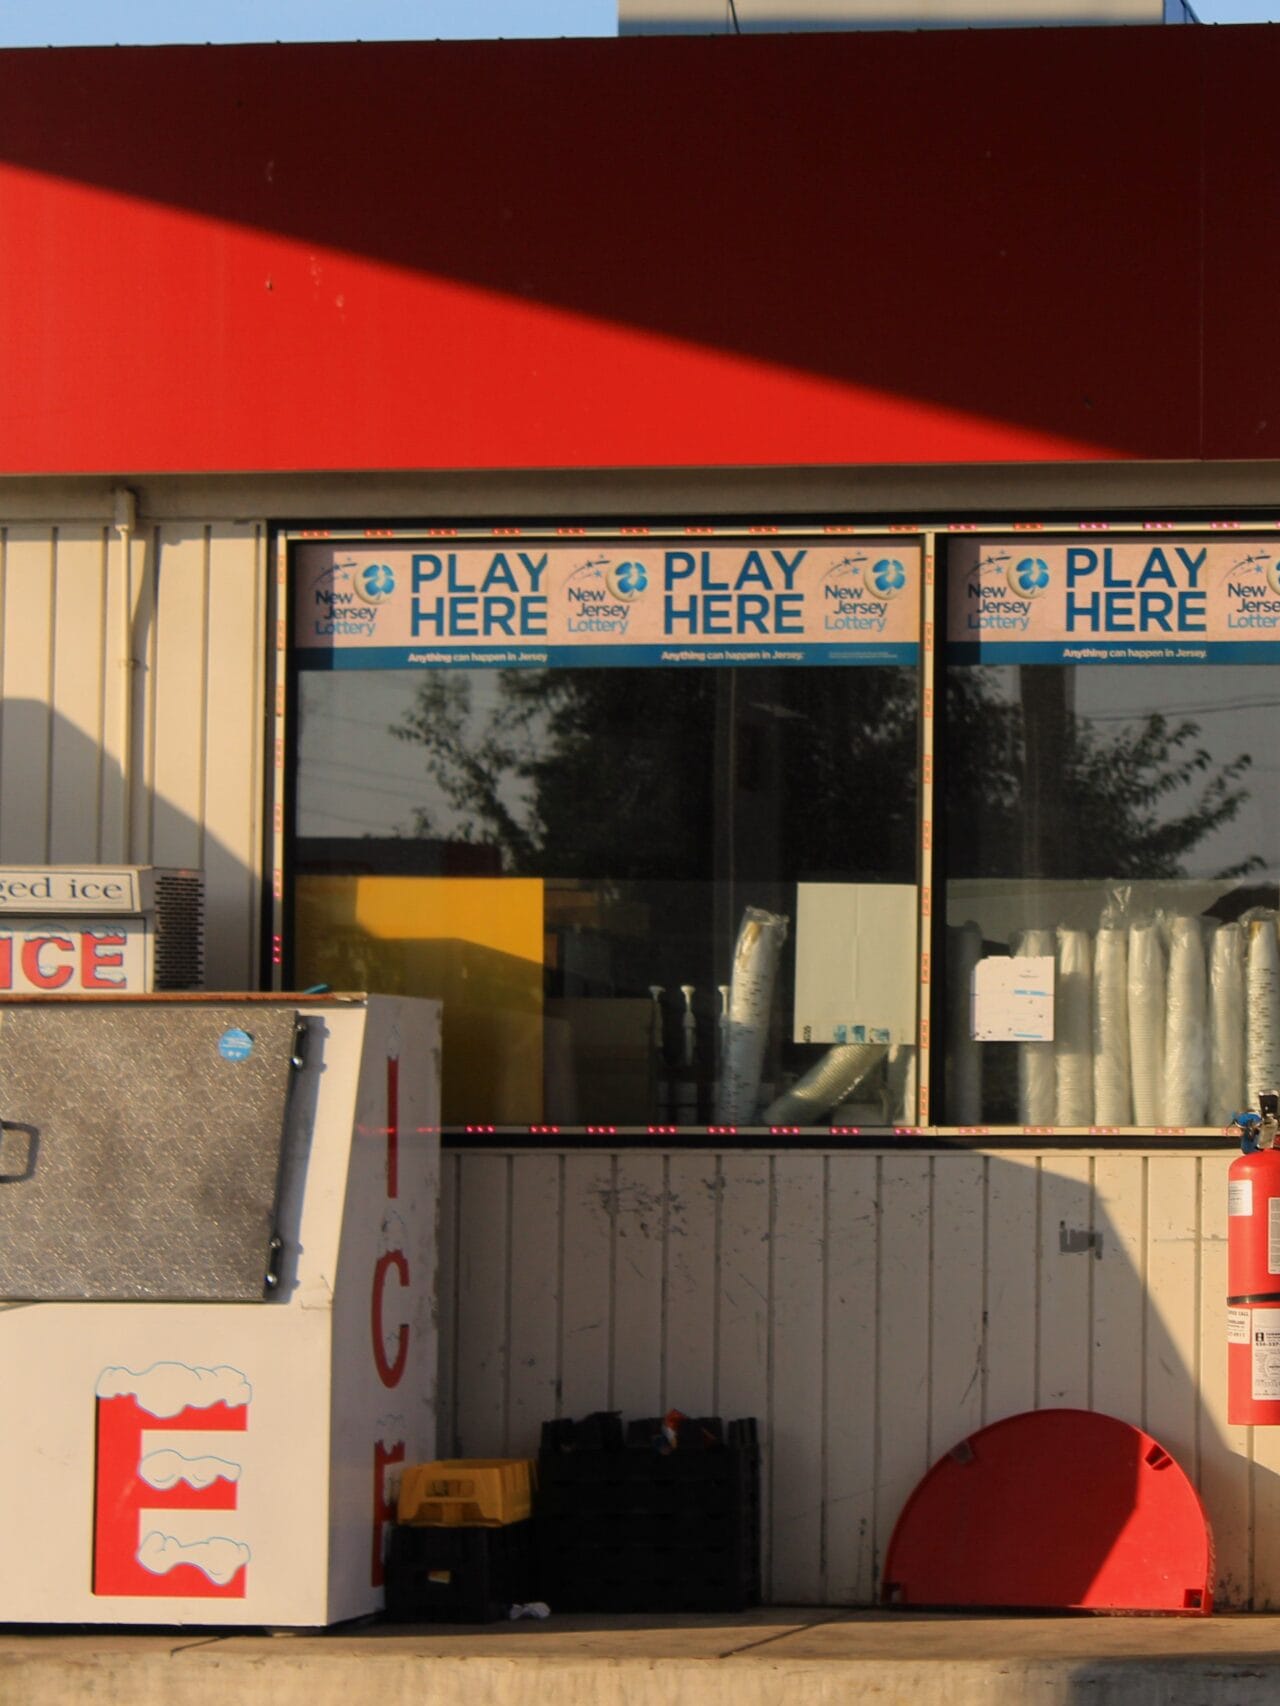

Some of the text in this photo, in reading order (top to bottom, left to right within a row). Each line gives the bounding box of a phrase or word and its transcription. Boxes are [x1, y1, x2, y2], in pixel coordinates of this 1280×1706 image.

[411, 553, 547, 593] PLAY
[664, 551, 807, 592] PLAY
[1066, 547, 1207, 588] PLAY
[315, 590, 354, 605] New
[568, 588, 606, 602] New
[825, 585, 864, 600] New
[968, 584, 1006, 598] New
[1228, 583, 1267, 598] New
[325, 607, 377, 622] Jersey
[576, 603, 630, 619] Jersey
[664, 594, 804, 635] HERE
[834, 602, 888, 617] Jersey
[976, 600, 1031, 616] Jersey
[1066, 591, 1207, 632] HERE
[411, 597, 547, 637] HERE
[824, 617, 887, 632] Lottery
[968, 615, 1030, 631] Lottery
[315, 622, 376, 637] Lottery
[568, 618, 629, 635] Lottery
[69, 877, 123, 900] ice
[0, 924, 127, 990] ICE
